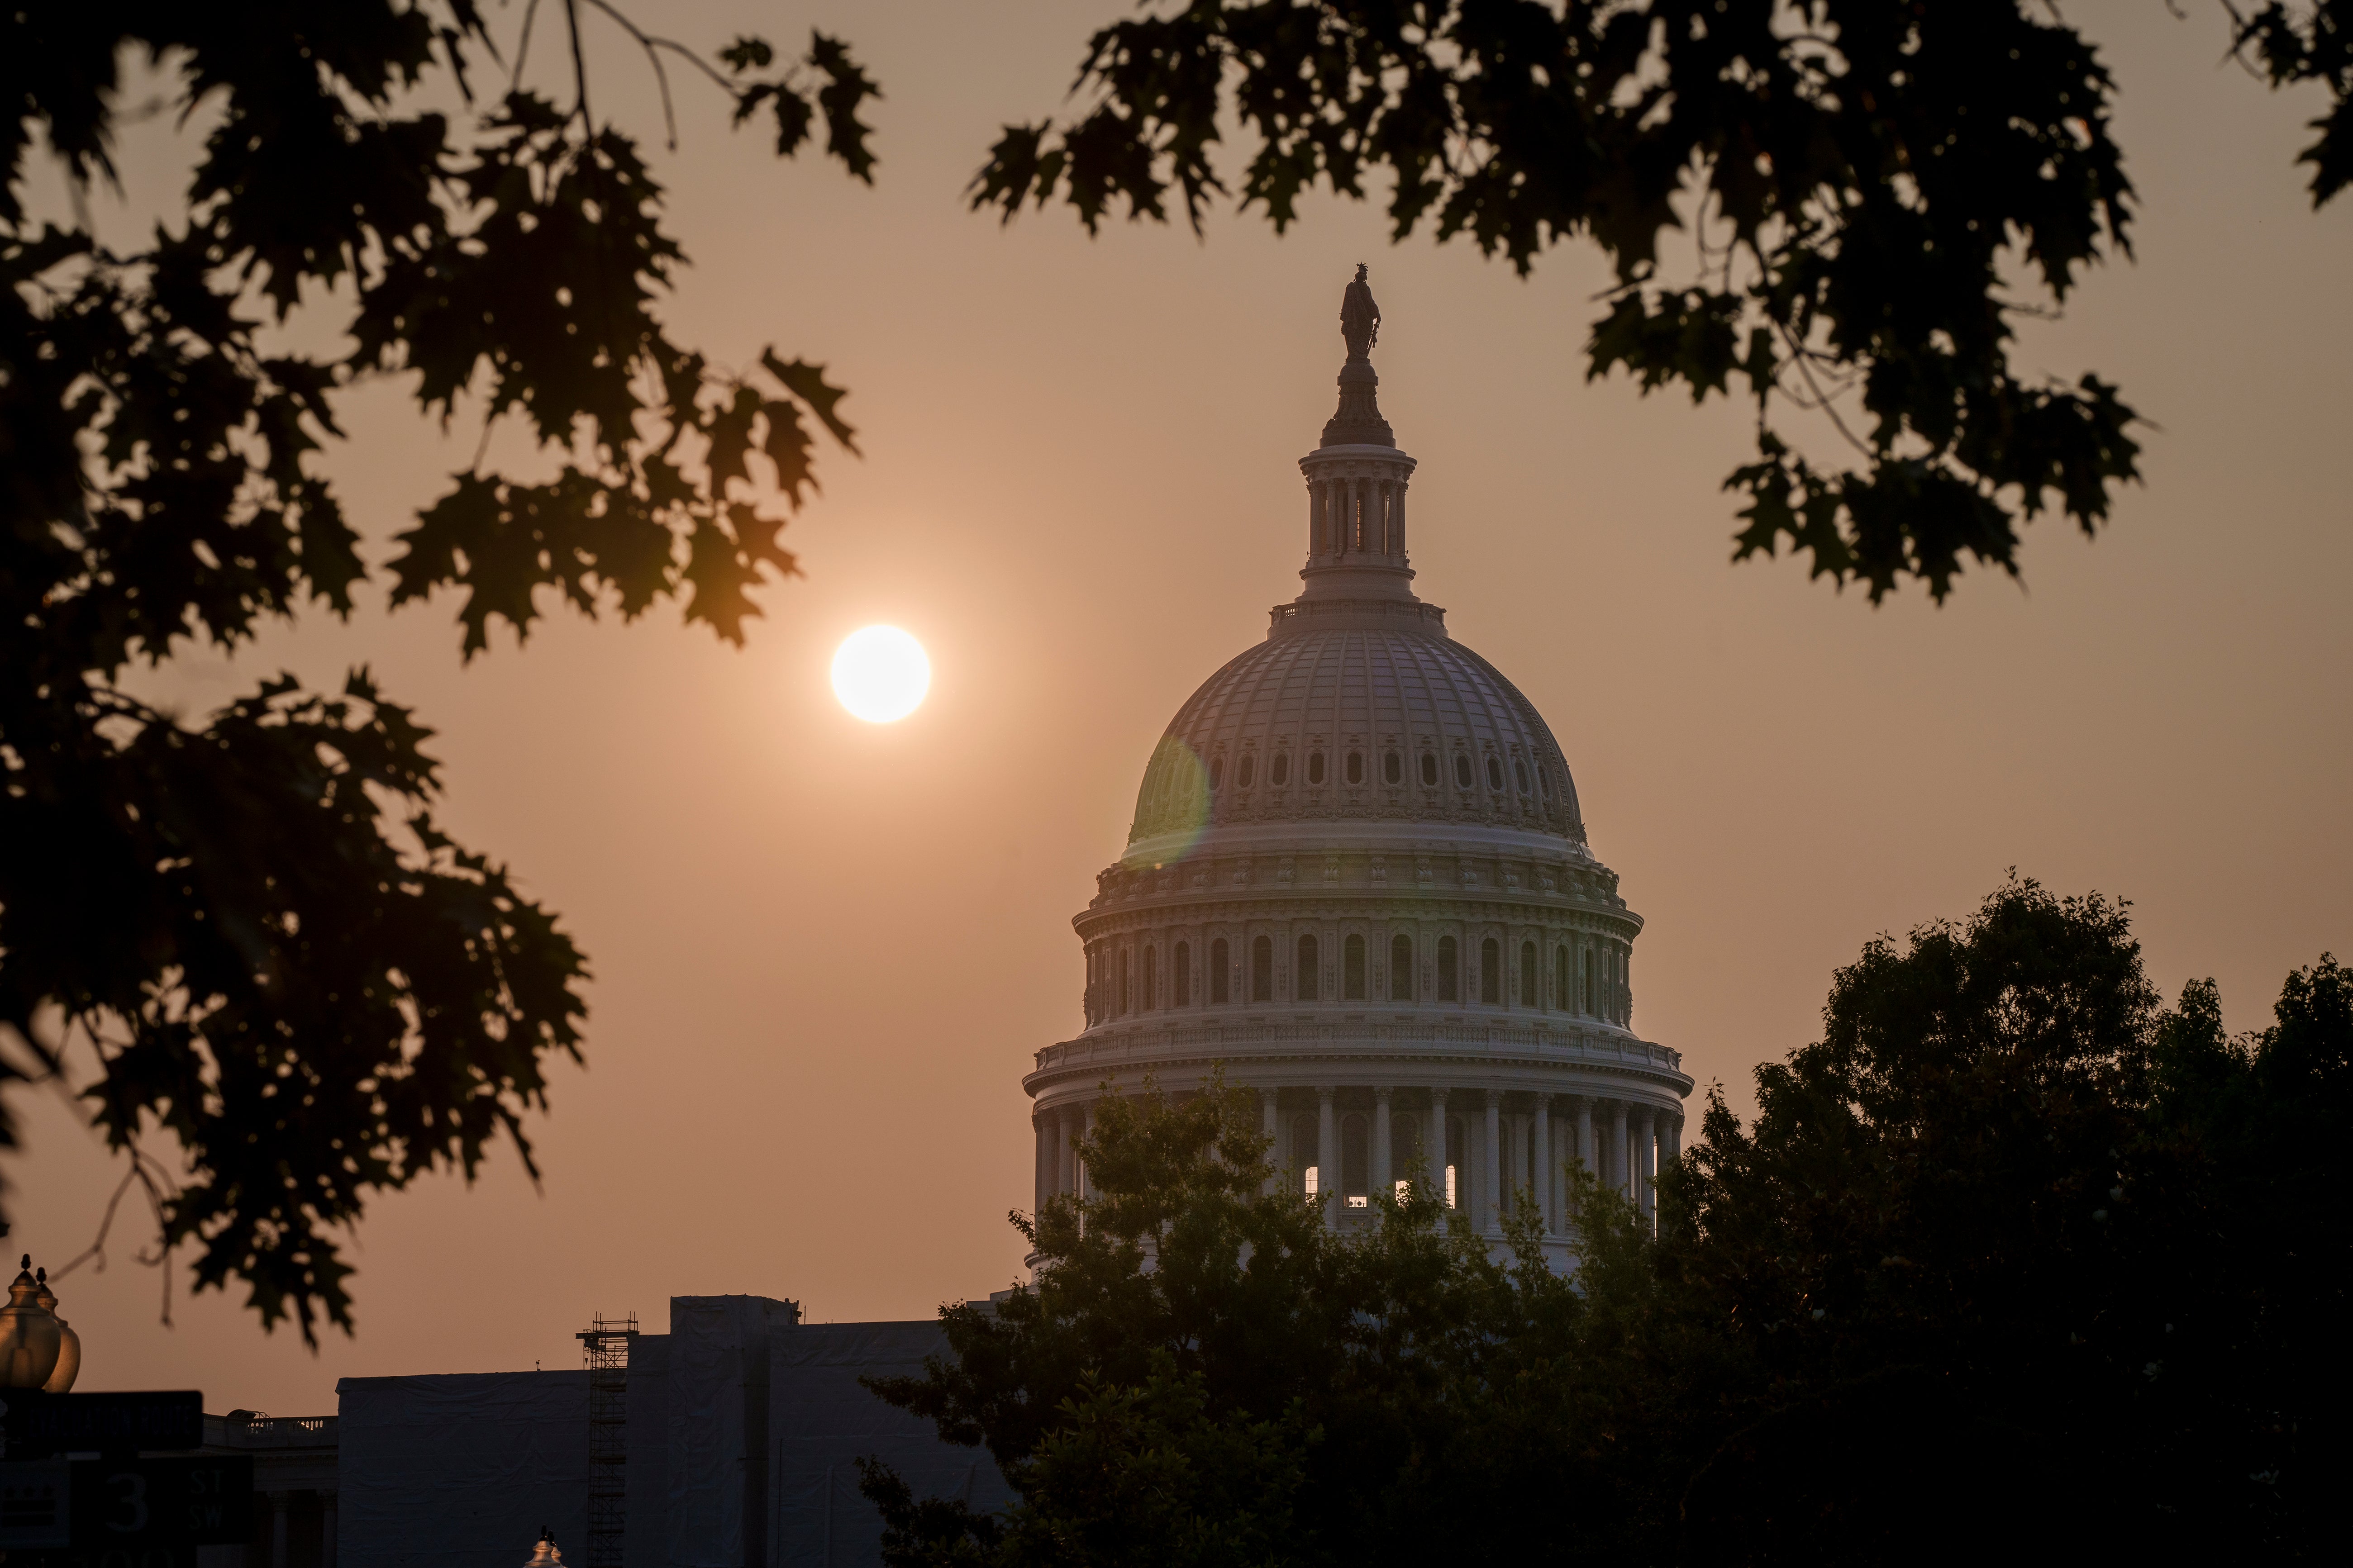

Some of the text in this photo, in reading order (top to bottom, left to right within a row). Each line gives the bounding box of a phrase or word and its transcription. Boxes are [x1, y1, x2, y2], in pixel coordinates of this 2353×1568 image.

[139, 1404, 193, 1435] ROUTE
[105, 1469, 224, 1533] 3 ST
[189, 1503, 223, 1530] SW
